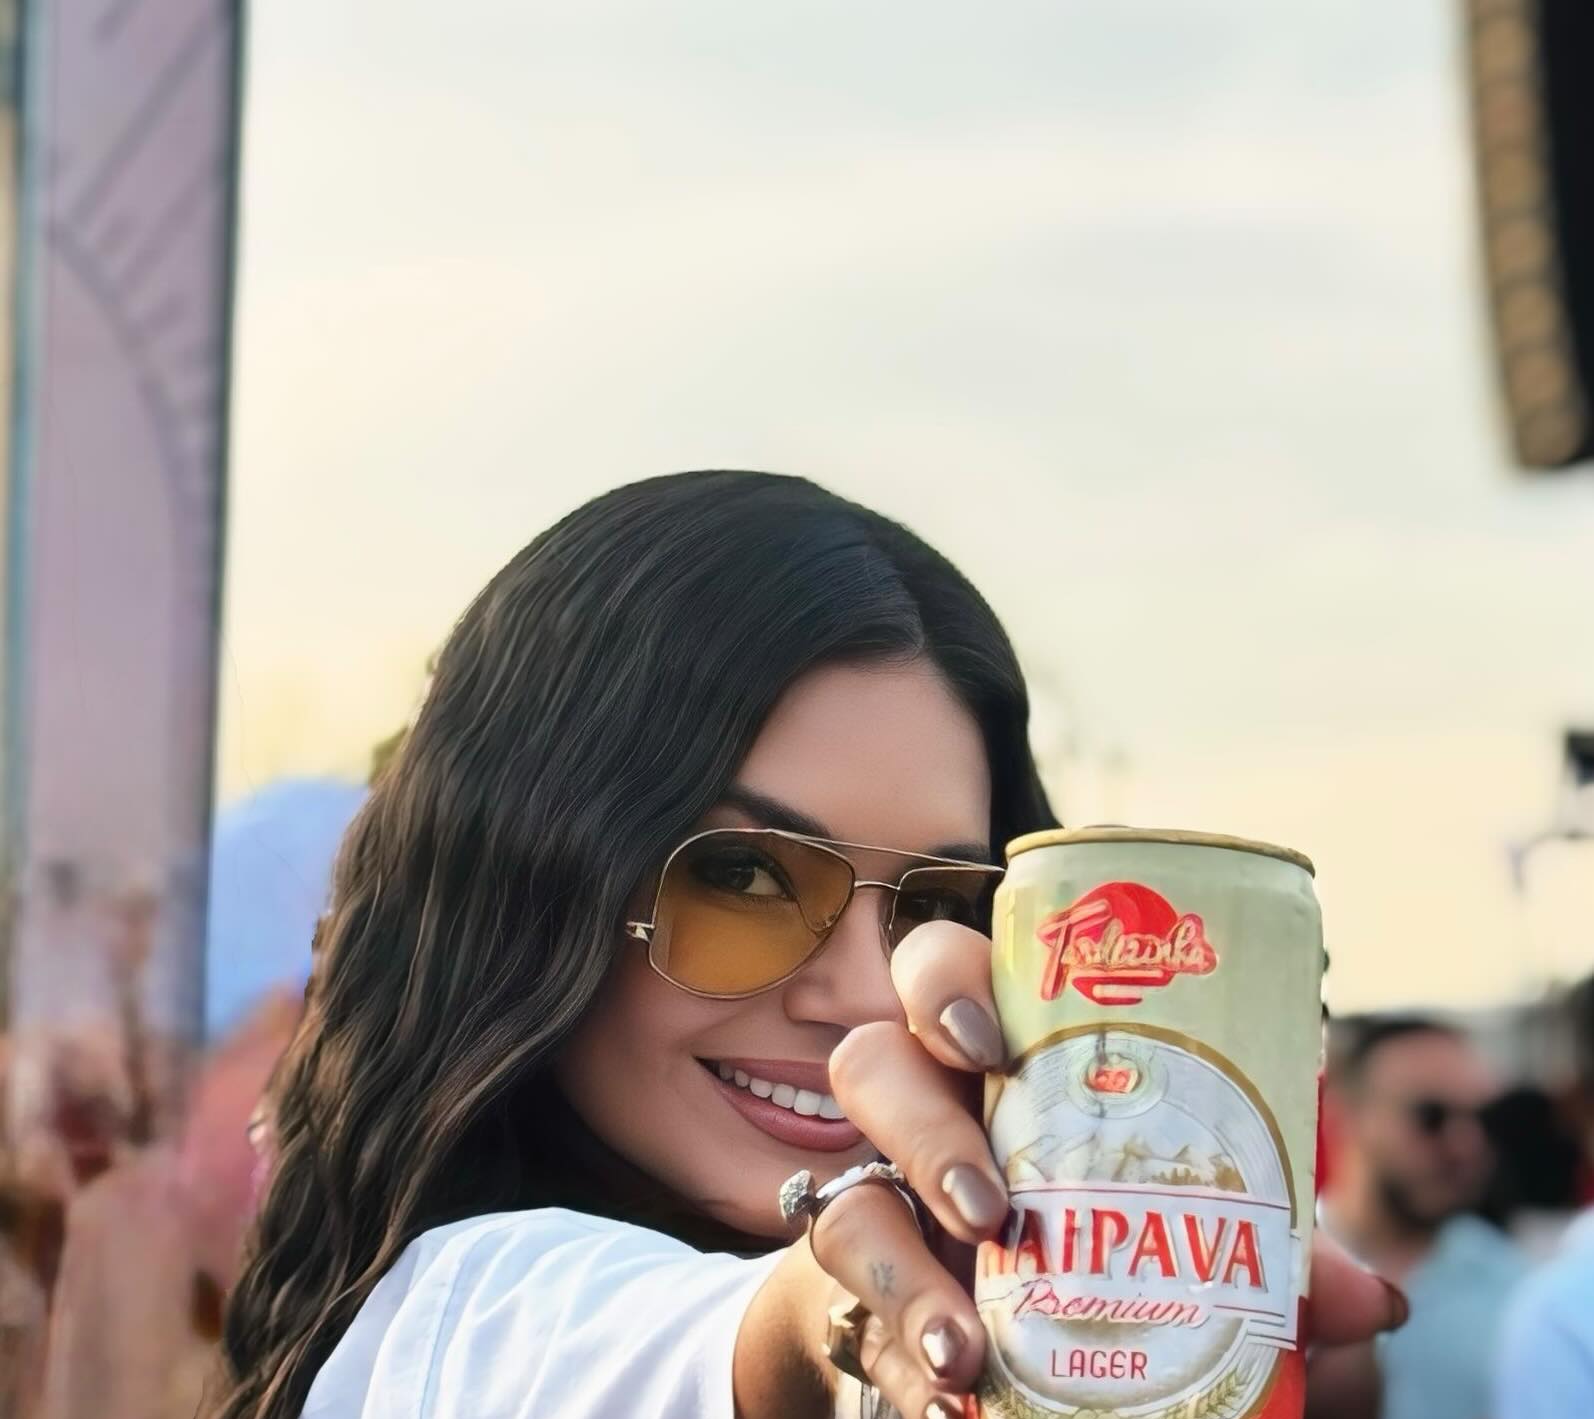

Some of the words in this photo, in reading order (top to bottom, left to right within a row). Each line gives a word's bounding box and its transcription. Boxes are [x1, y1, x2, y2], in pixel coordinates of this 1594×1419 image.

[983, 1207, 1267, 1291] AIPAVA
[1013, 1278, 1204, 1326] Premium
[1051, 1349, 1148, 1381] LAGER
